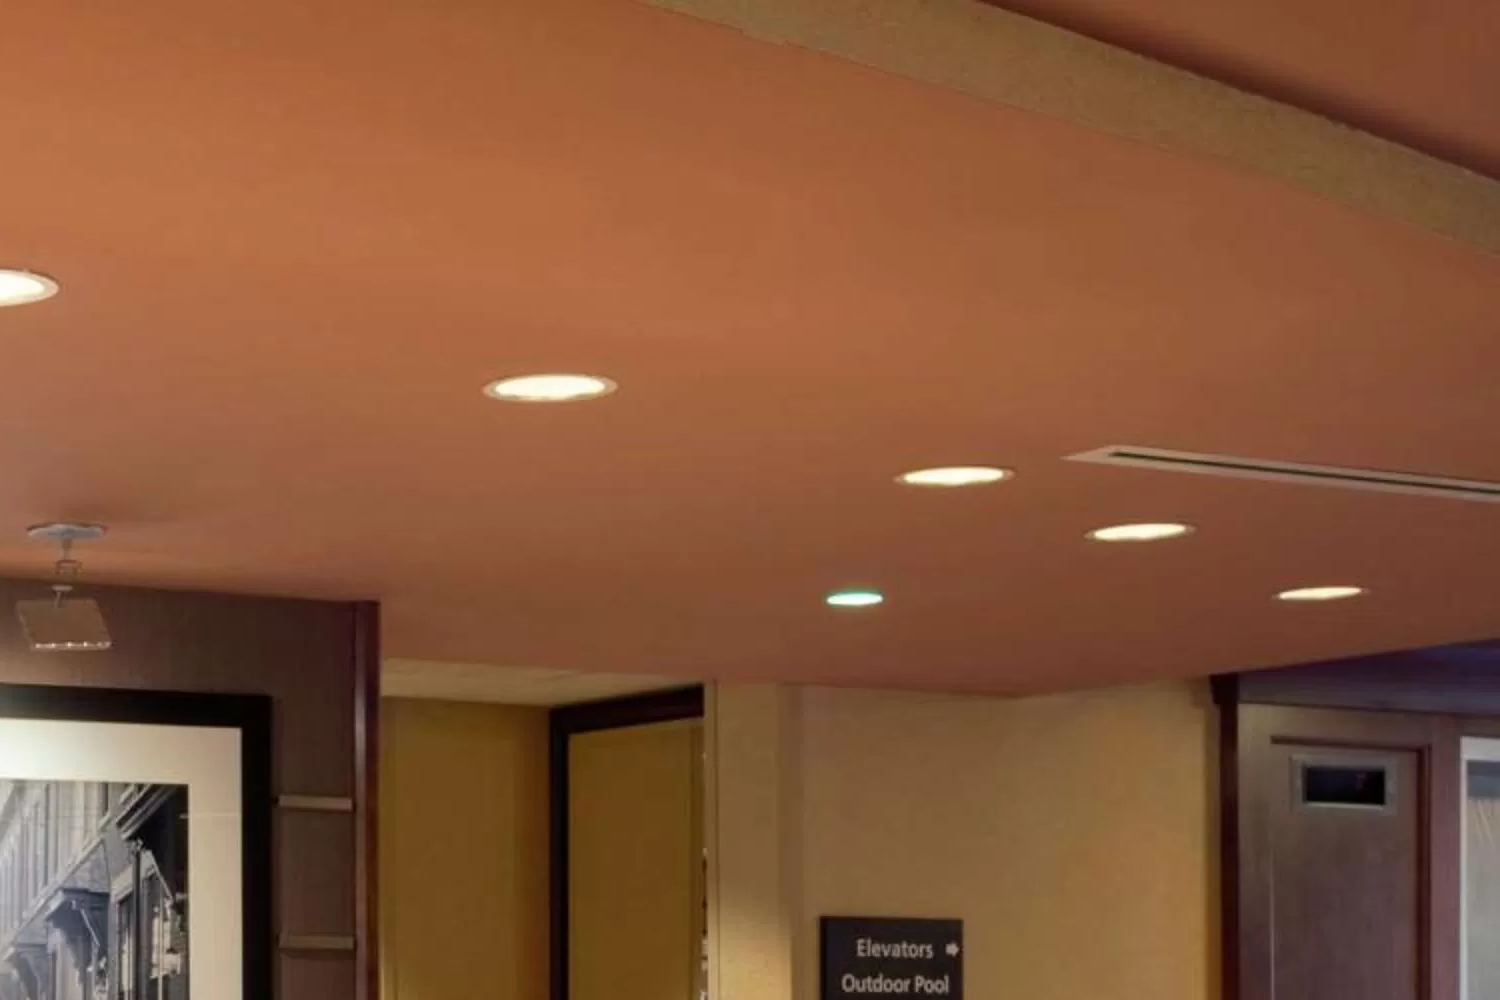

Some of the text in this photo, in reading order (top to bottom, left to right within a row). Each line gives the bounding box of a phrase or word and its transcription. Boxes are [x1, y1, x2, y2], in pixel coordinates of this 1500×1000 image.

[856, 938, 934, 959] Elevators
[841, 973, 949, 994] Outdoor Pool
